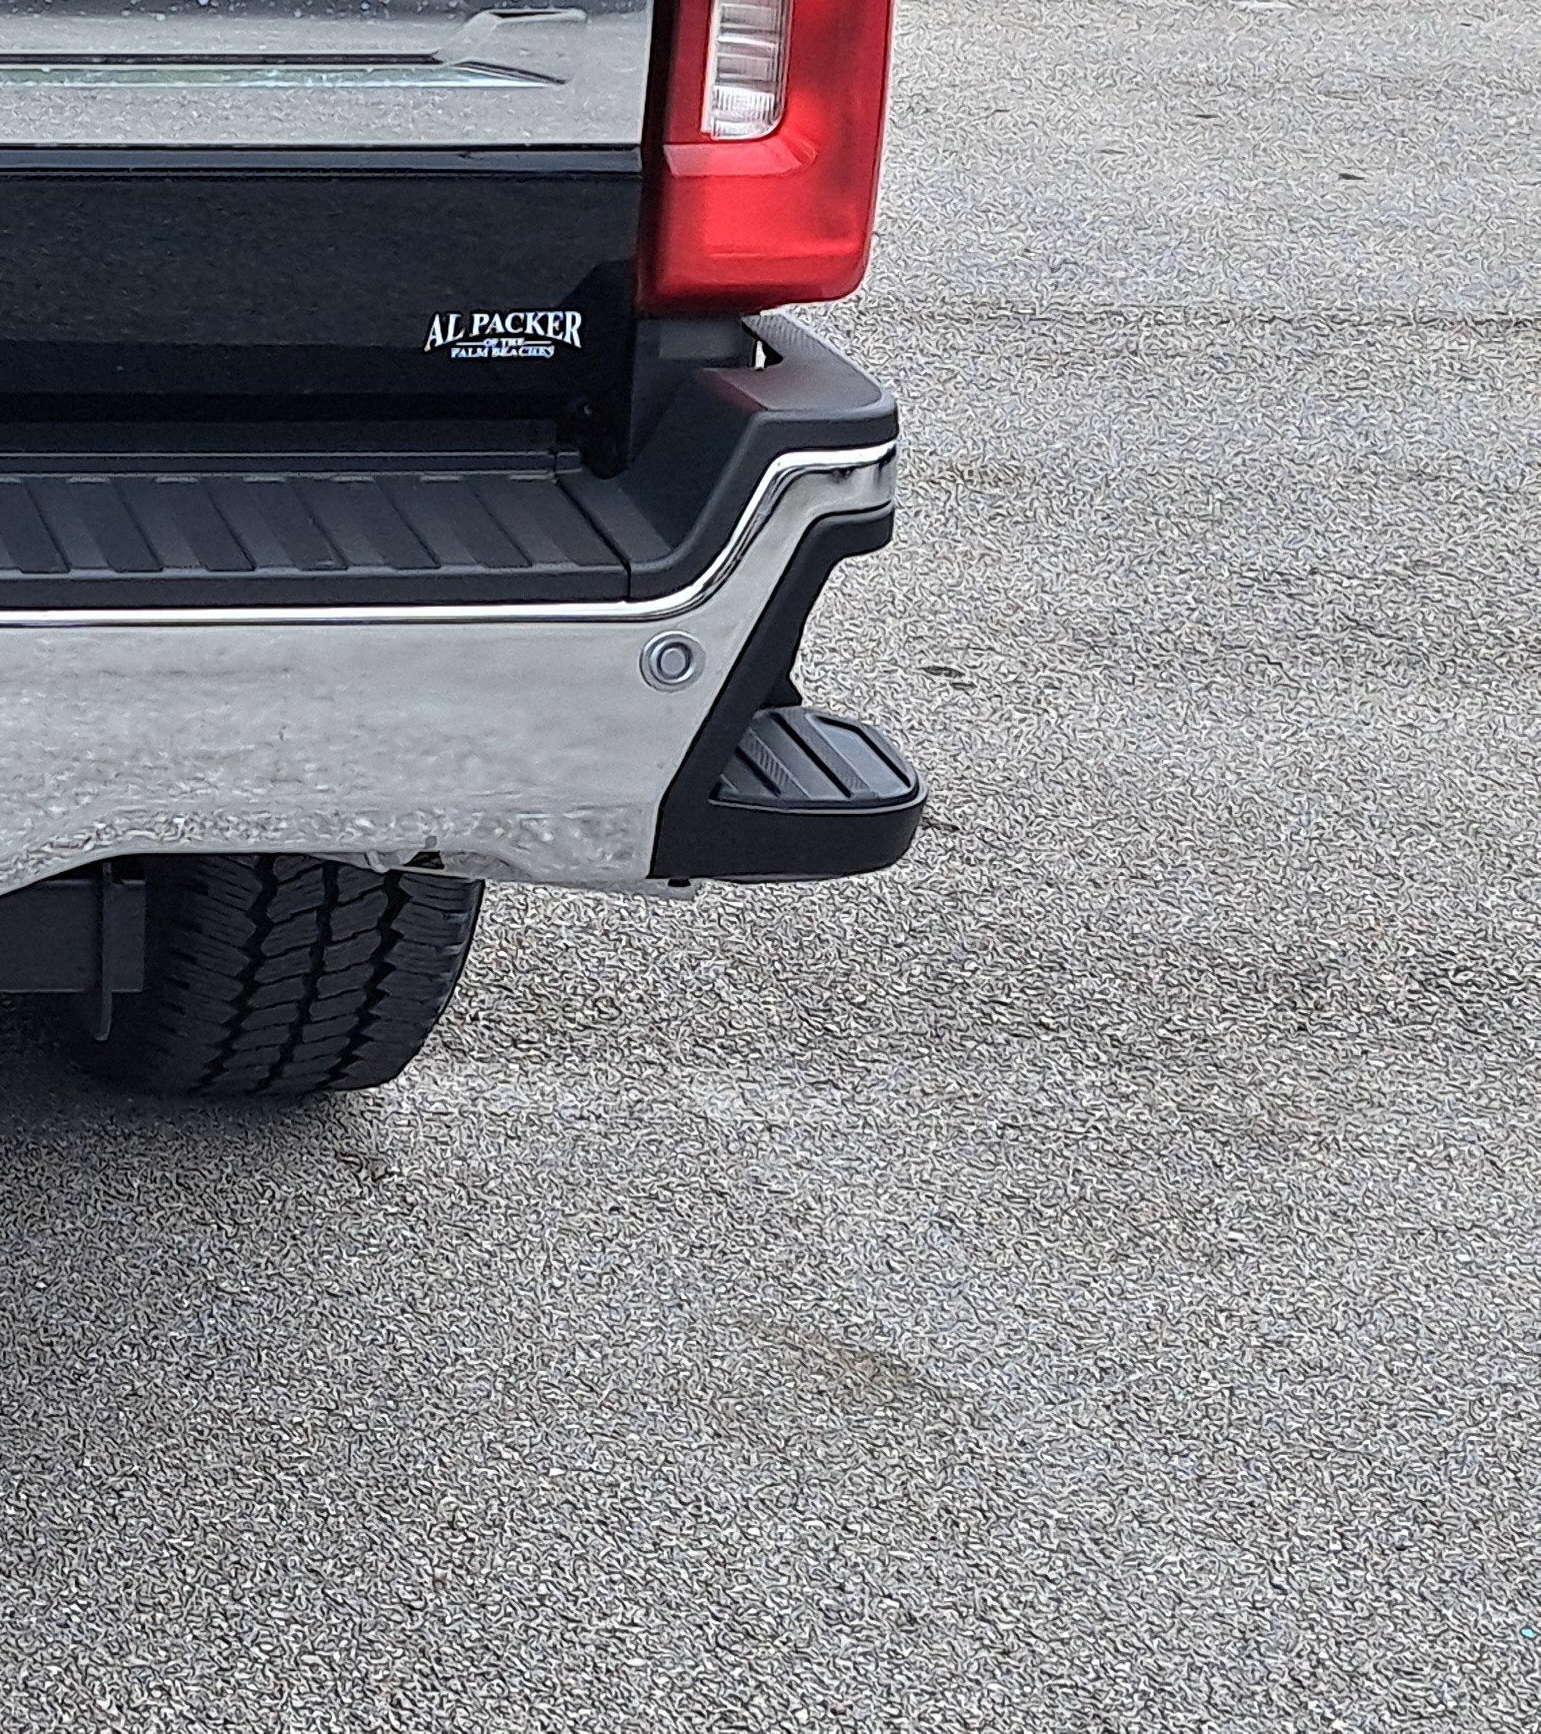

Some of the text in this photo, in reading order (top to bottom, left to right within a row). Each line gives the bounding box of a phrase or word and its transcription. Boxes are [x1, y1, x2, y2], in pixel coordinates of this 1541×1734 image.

[424, 311, 583, 352] AL PACKER
[451, 347, 488, 358] PALM
